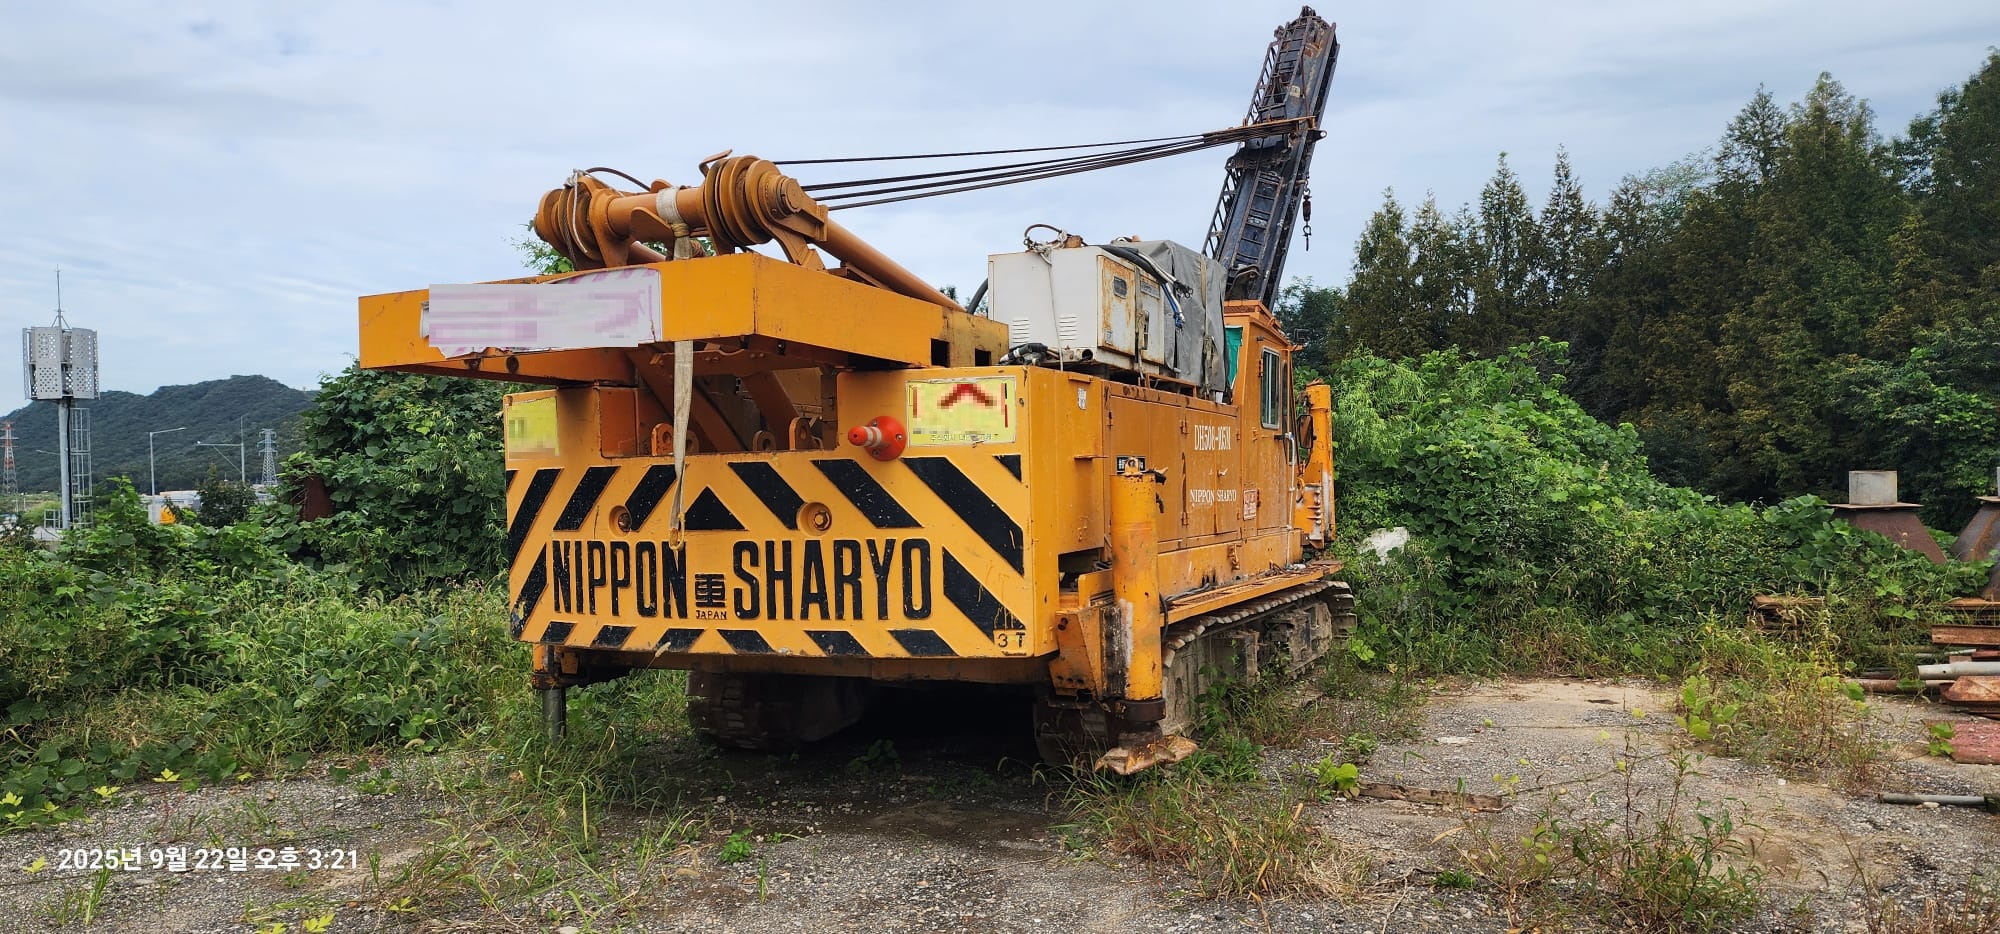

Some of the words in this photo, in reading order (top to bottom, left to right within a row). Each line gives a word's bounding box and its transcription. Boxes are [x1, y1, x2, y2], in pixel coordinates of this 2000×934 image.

[1190, 489, 1215, 504] NIPPON
[1217, 489, 1237, 502] SHARYO
[552, 540, 688, 620] NIPPON
[733, 538, 932, 621] SHARYO
[695, 609, 728, 621] JAPAN
